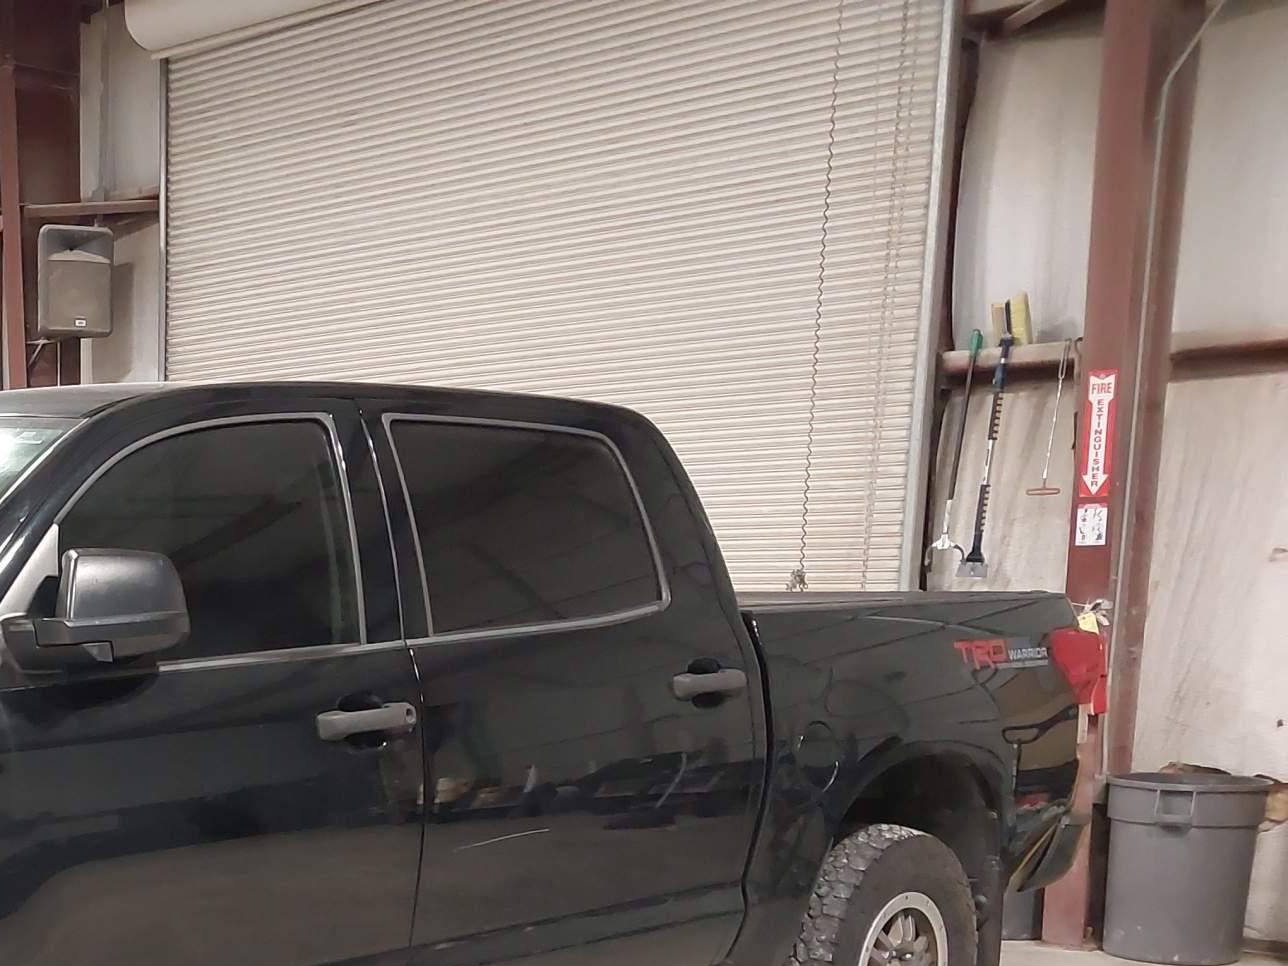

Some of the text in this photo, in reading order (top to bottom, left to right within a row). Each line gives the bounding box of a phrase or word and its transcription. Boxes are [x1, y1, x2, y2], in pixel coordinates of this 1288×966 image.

[1092, 383, 1113, 395] FIRE
[1090, 399, 1105, 488] EXTINGUISHER
[954, 639, 1048, 671] TRD WARRIOR
